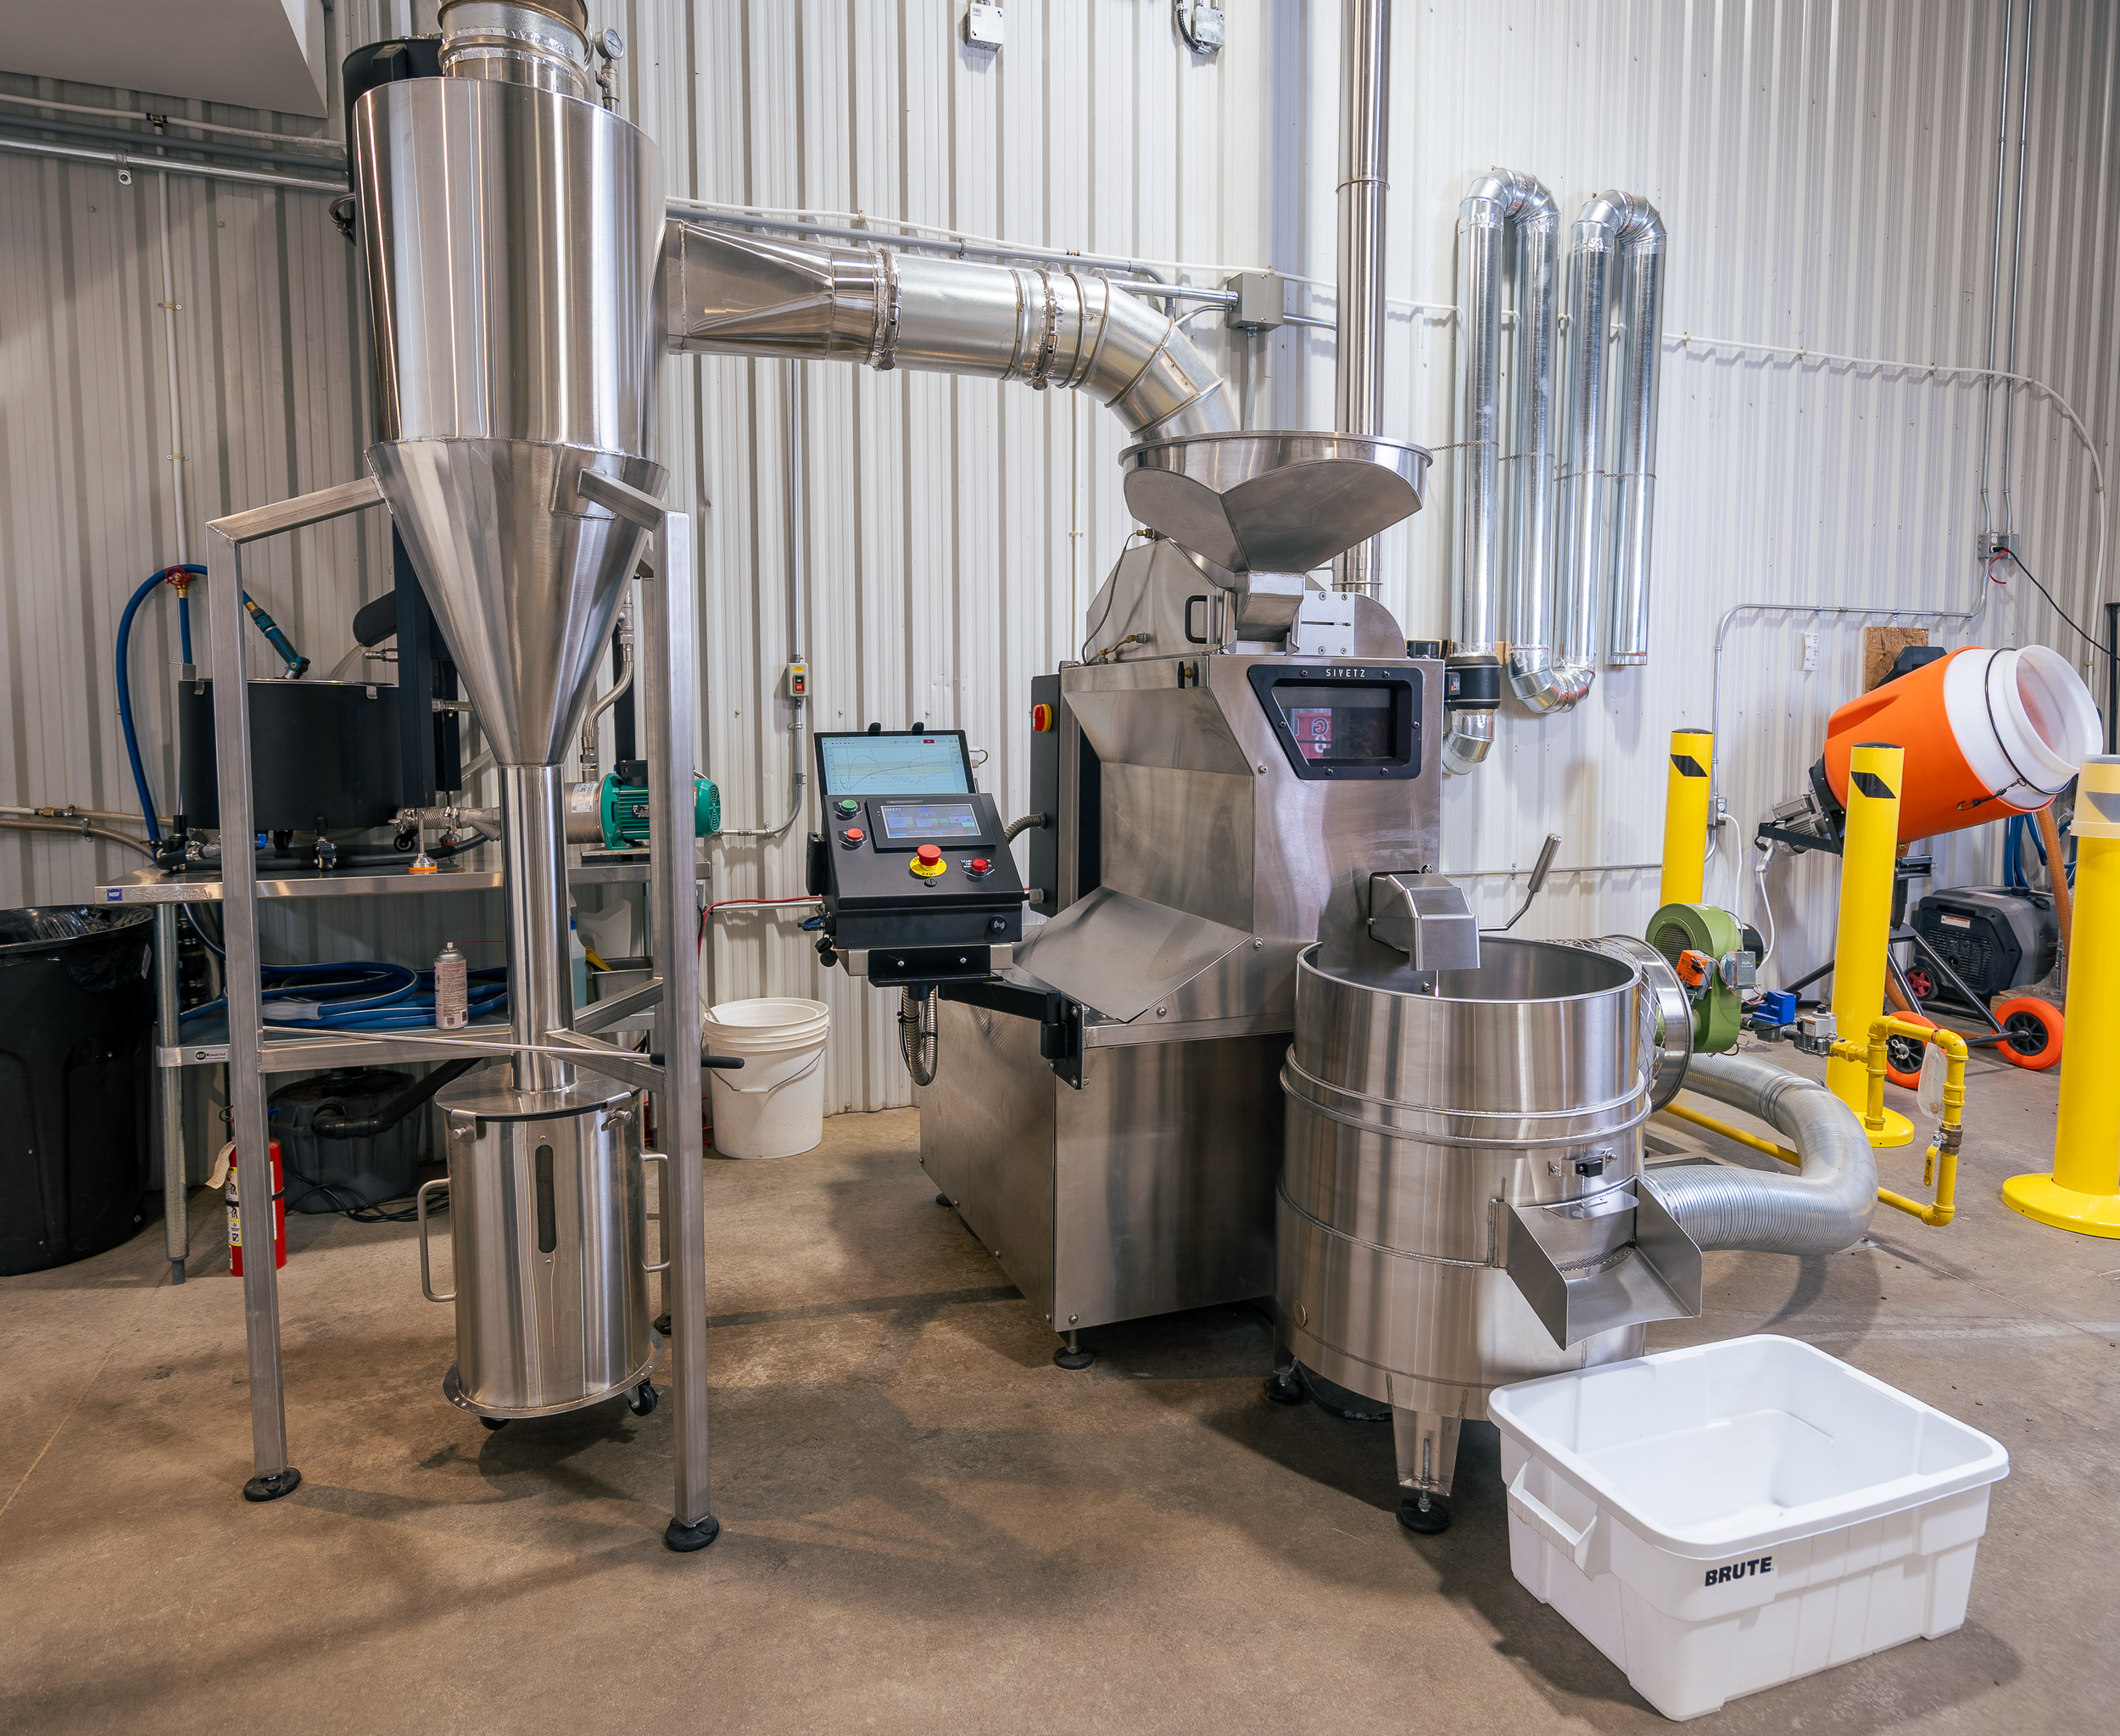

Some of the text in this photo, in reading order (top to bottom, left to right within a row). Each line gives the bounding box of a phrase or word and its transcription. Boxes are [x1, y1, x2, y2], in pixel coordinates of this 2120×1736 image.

[1326, 669, 1365, 678] SIVETZ
[142, 887, 210, 901] SAGETRA
[1704, 1556, 1772, 1587] BRUTE
